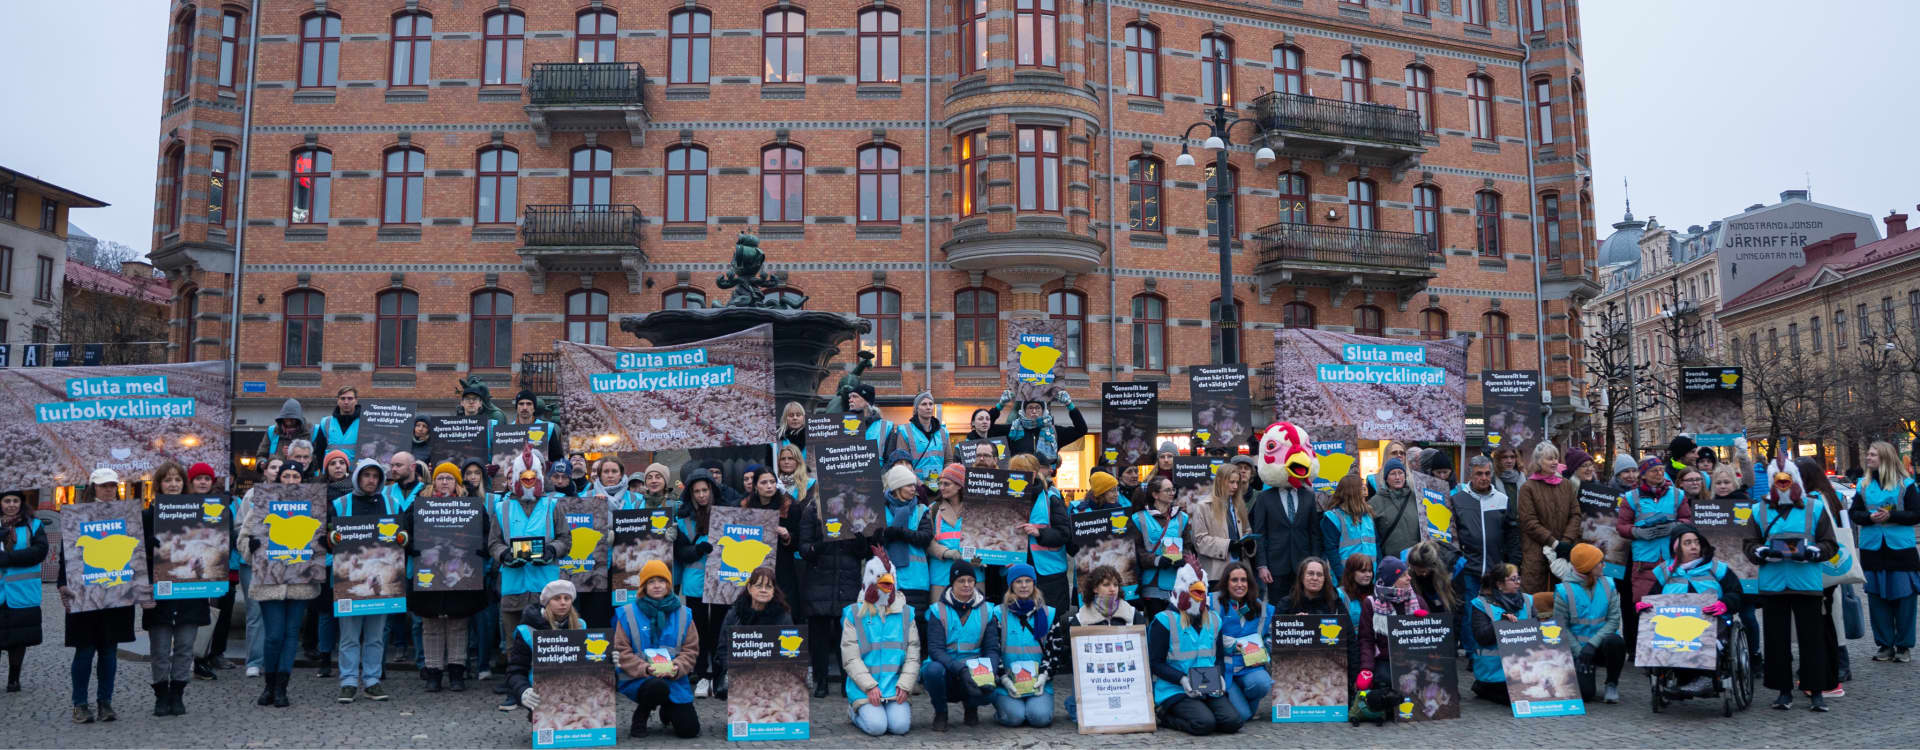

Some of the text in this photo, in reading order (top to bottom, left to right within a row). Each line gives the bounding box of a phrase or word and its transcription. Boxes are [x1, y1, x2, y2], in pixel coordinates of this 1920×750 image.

[1726, 232, 1808, 248] JÄRNAFFÄR
[25, 346, 36, 366] A
[620, 349, 704, 368] Sluta med
[1347, 346, 1423, 363] Sluta med
[593, 368, 732, 391] turbokycklingar!
[1321, 366, 1443, 386] turbokycklingar!
[71, 377, 165, 396] Sluta med
[40, 400, 193, 422] turbokycklingar!
[159, 503, 200, 512] Systematiskt
[732, 631, 763, 639] Svenska
[1275, 628, 1315, 637] kycklingars
[537, 635, 569, 643] Svenska
[1275, 637, 1313, 645] verklighet!
[537, 645, 581, 654] kycklingars
[732, 641, 774, 649] kycklingars
[537, 654, 578, 663] verklighet!
[732, 650, 772, 659] verklighet!
